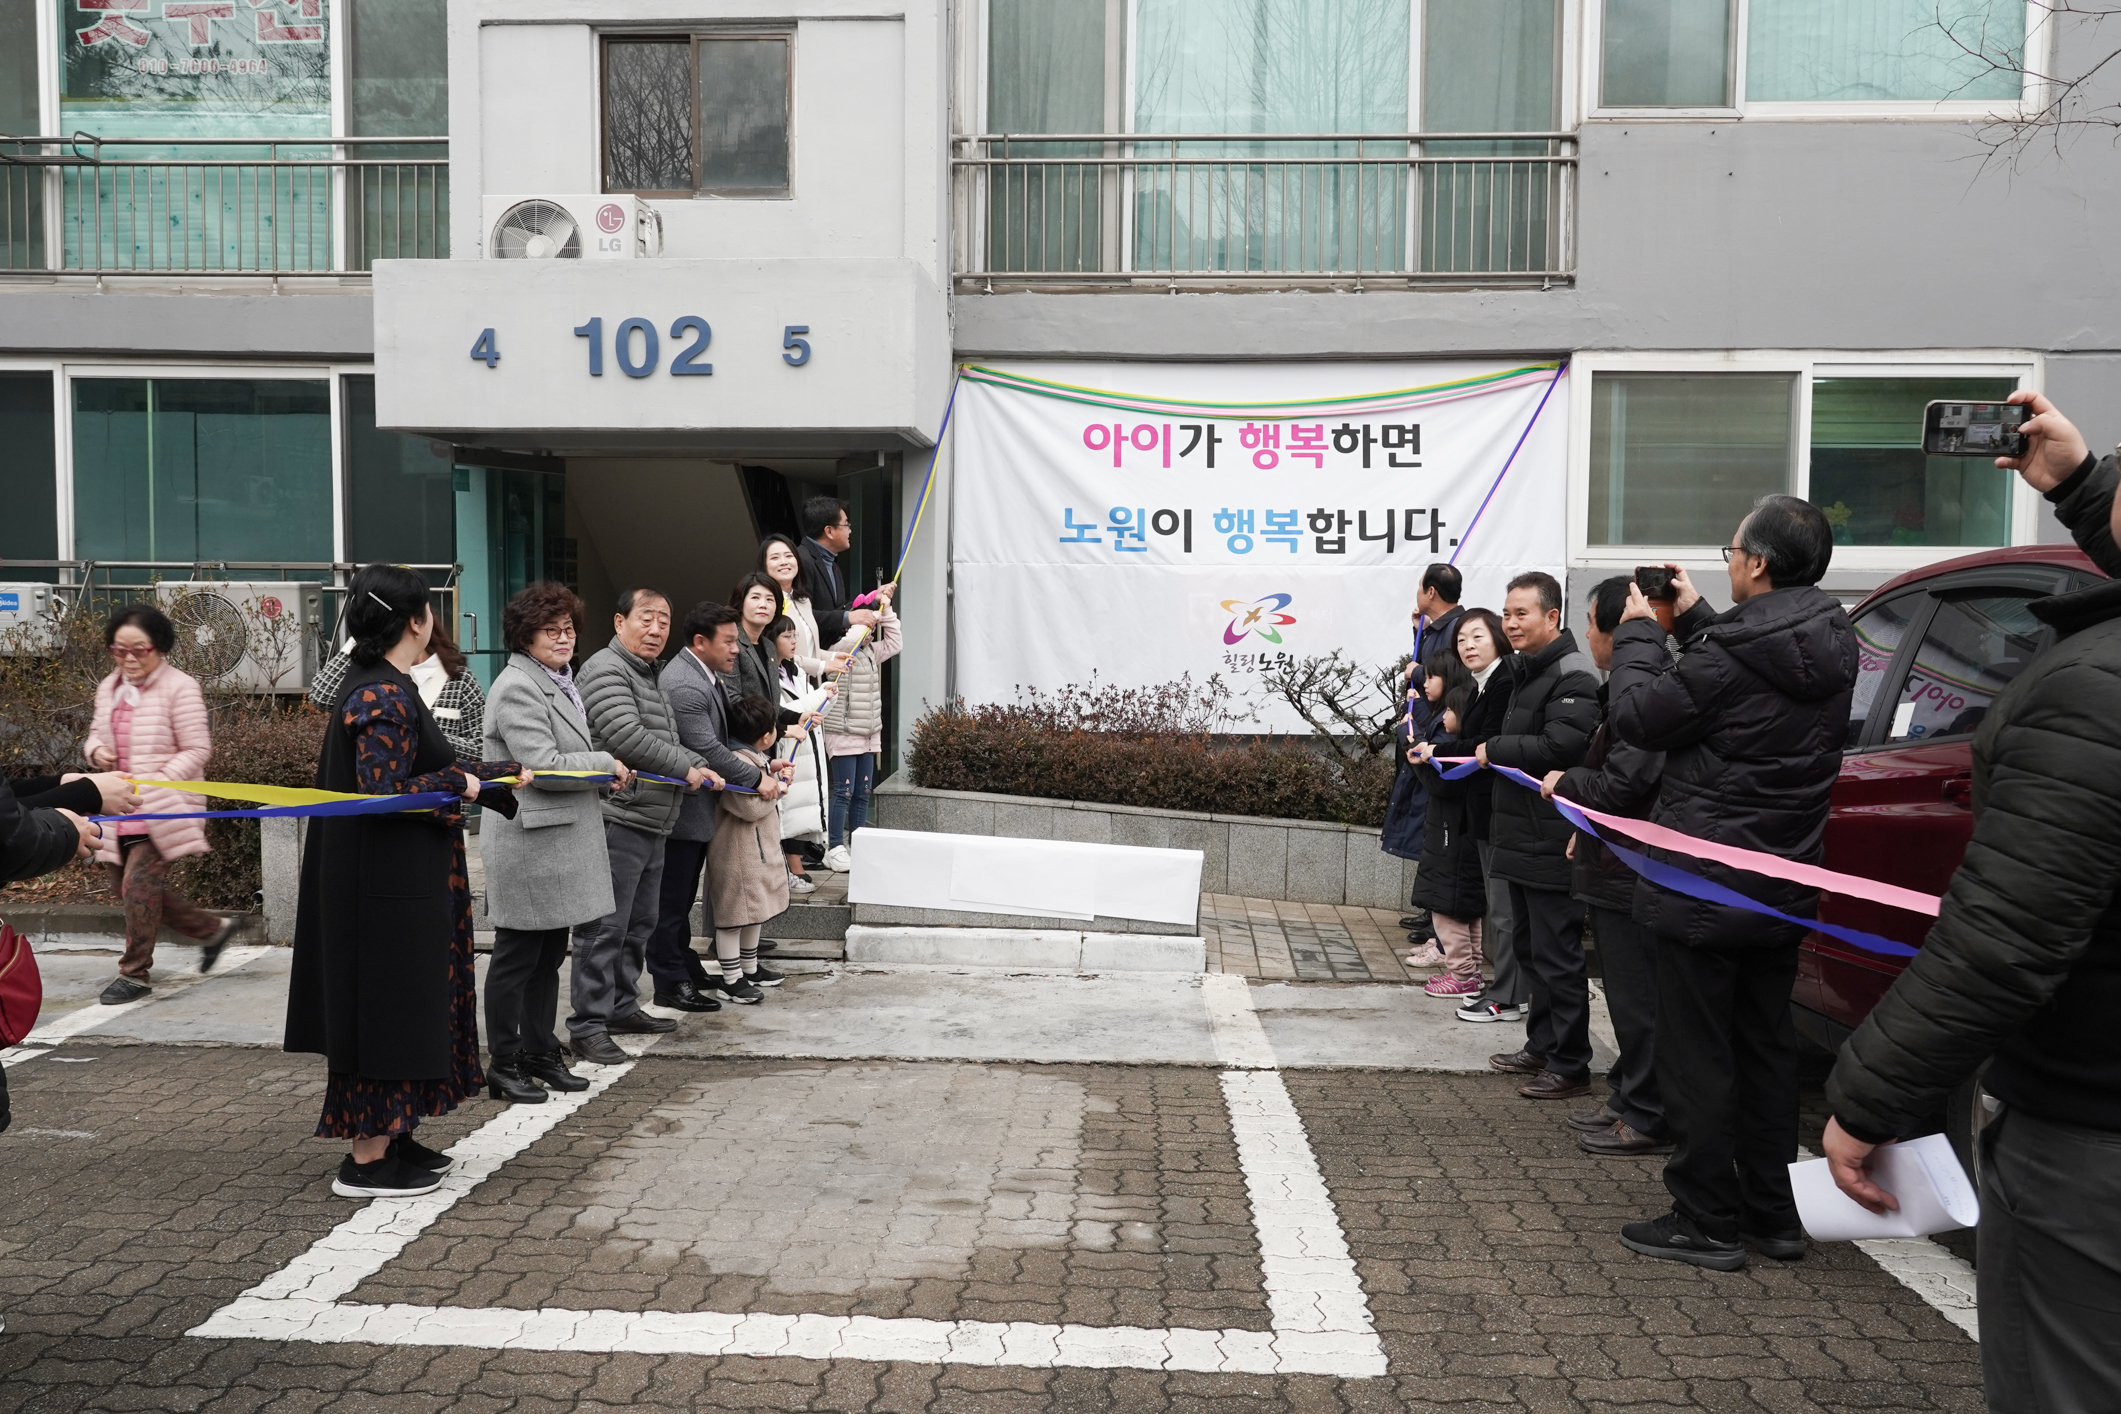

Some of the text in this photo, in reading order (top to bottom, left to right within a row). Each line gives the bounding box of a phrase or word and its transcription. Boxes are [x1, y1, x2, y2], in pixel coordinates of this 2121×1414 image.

[599, 238, 621, 252] LG
[471, 315, 811, 377] 4 102 5
[1083, 423, 1422, 469] 아이가 행복하면
[1059, 507, 1458, 554] 노원이 행복합니다.
